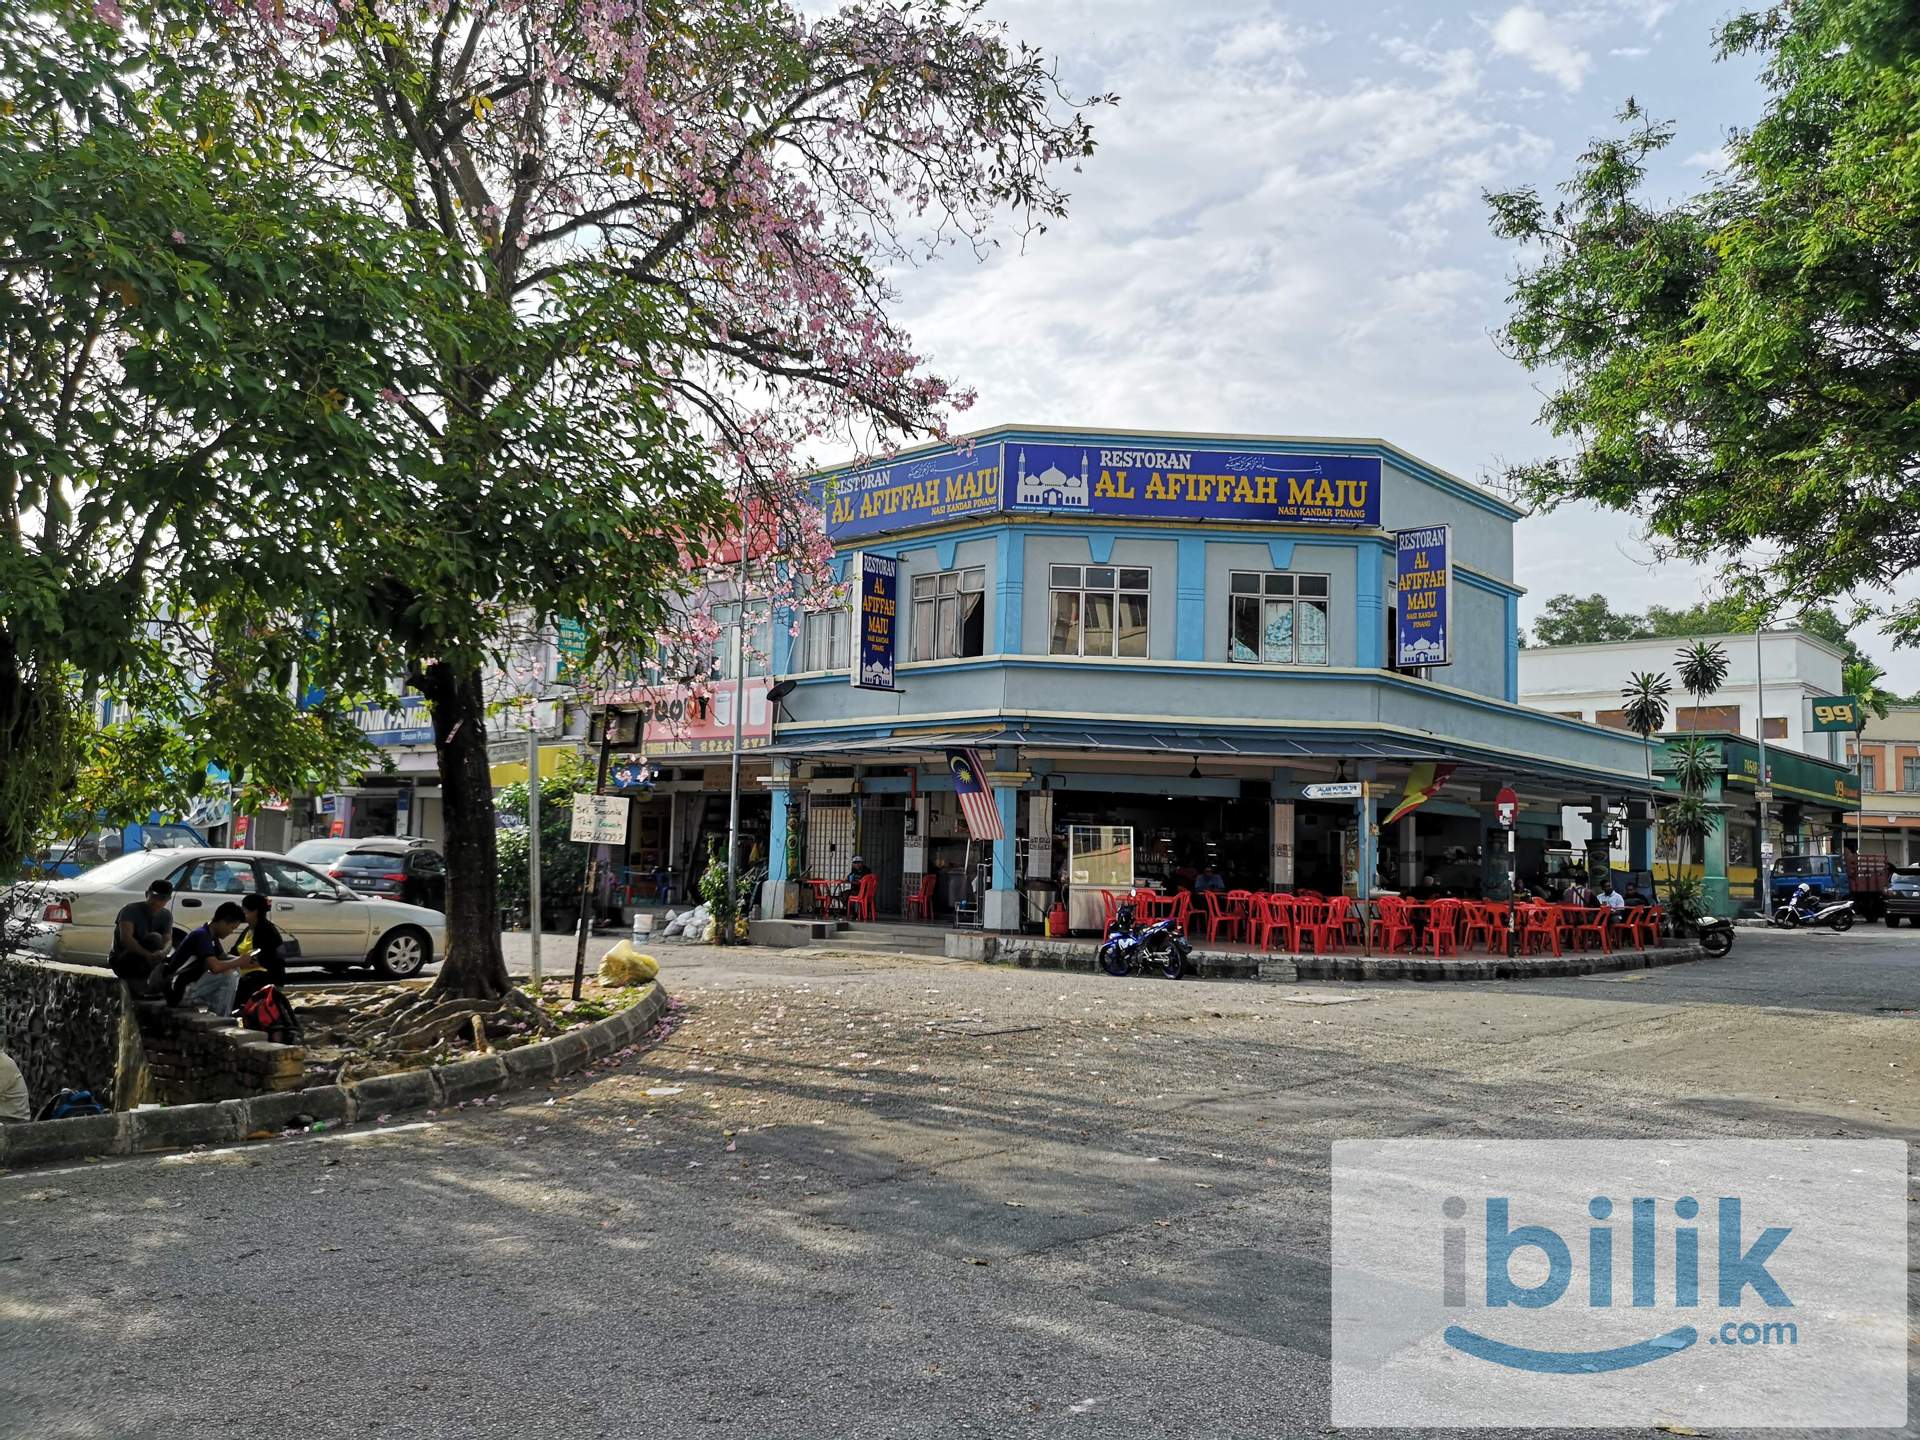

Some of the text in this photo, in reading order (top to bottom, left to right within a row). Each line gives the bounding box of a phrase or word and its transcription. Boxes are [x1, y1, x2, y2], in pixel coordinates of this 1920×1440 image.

[1100, 450, 1192, 470] RESTORAN
[832, 470, 891, 495] RESTORAN
[1094, 470, 1368, 508] AL AFIFFAH MAJU
[831, 495, 855, 524] AL
[860, 477, 941, 519] AFIFFAH
[944, 465, 999, 505] MAJU
[931, 505, 946, 517] NASI
[948, 501, 972, 513] KANDAR
[972, 497, 998, 509] PINANG
[1278, 506, 1365, 519] NASI KANDAR PINANG
[1399, 528, 1445, 551] RESTORAN
[863, 555, 896, 577] RESTORAN
[1414, 551, 1429, 570] AL
[874, 577, 885, 595] AL
[1399, 569, 1446, 592] AFIFFAH
[863, 594, 896, 616] AFIFFAH
[1407, 591, 1437, 611] MAJU
[868, 615, 889, 635] MAJU
[1814, 704, 1853, 724] 99
